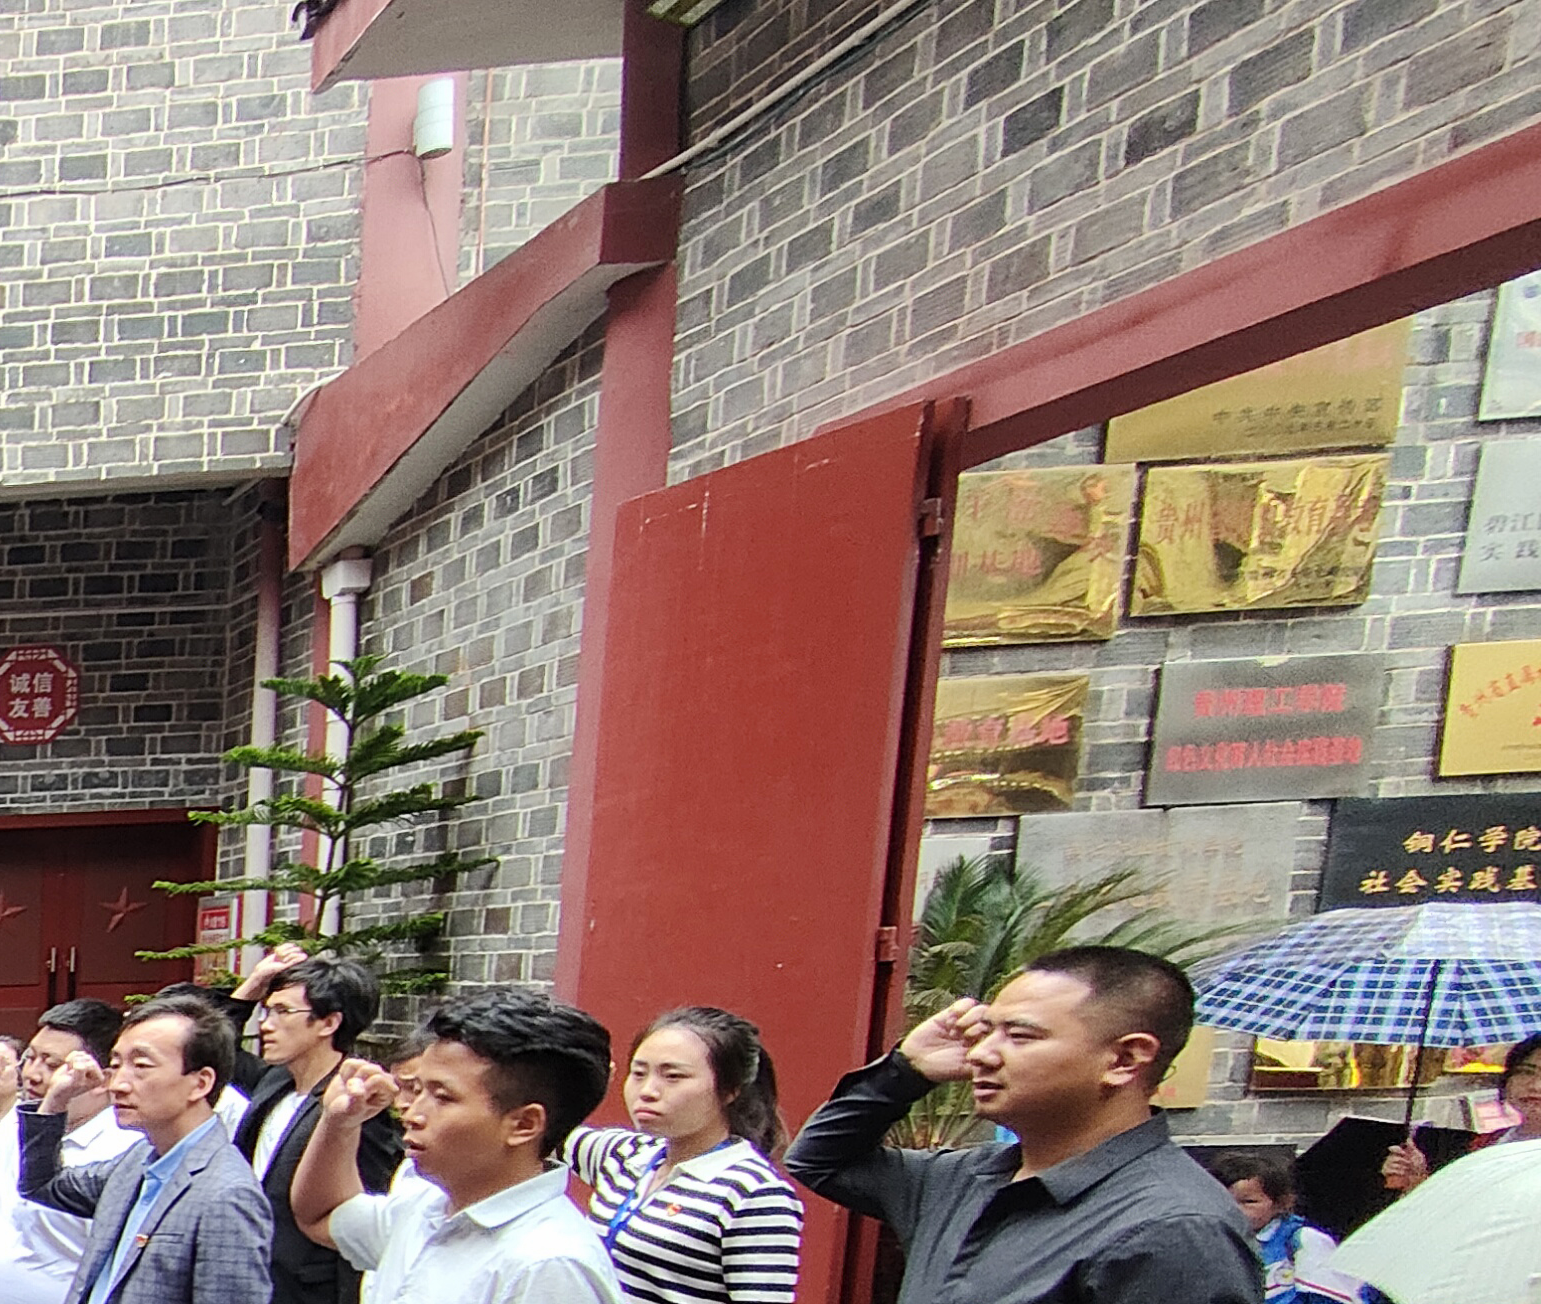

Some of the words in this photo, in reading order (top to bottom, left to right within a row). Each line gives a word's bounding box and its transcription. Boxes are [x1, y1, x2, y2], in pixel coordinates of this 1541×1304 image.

[9, 672, 54, 693] 诚信
[8, 697, 53, 718] 友善
[1402, 825, 1541, 854] 铜仁学院
